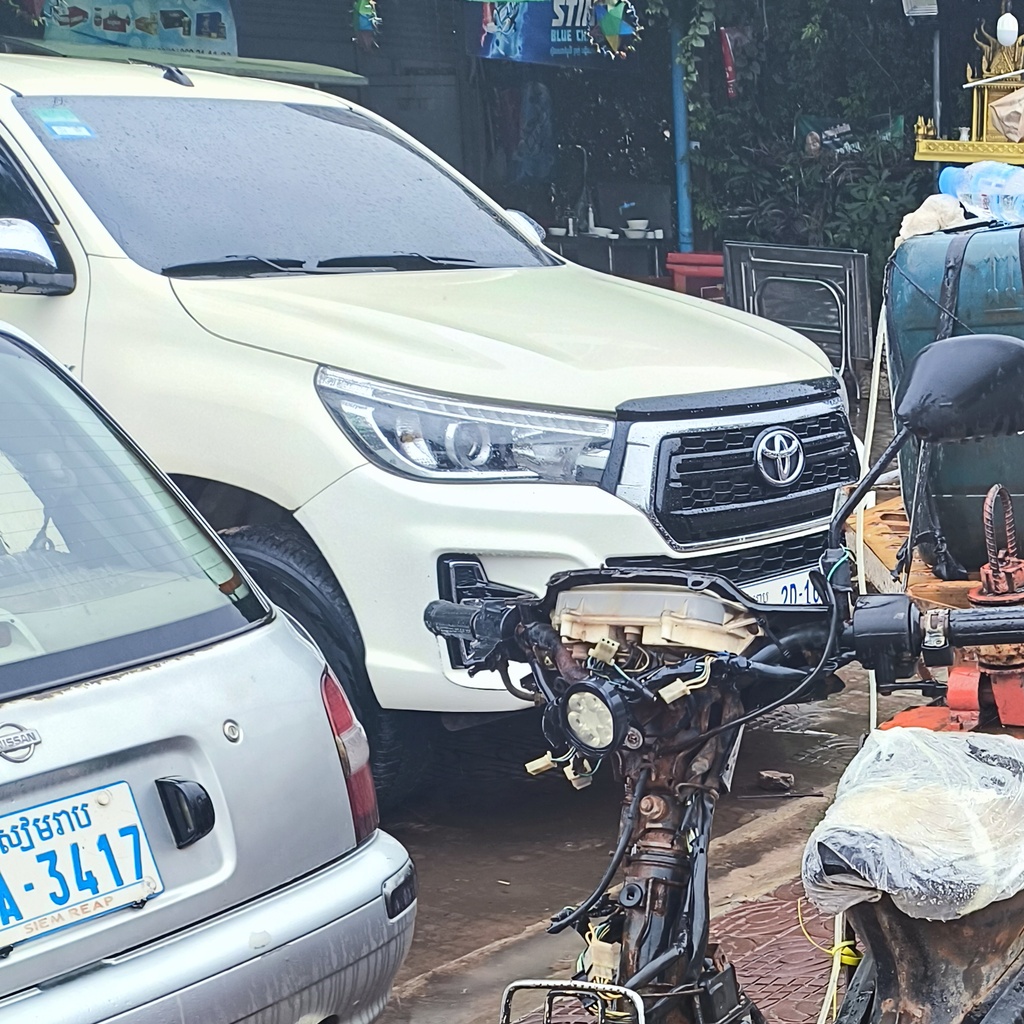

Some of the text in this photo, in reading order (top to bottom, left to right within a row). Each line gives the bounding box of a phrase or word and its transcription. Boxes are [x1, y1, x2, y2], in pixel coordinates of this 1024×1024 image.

[551, 29, 572, 42] BLUE
[24, 896, 114, 934] SIEM REAP
